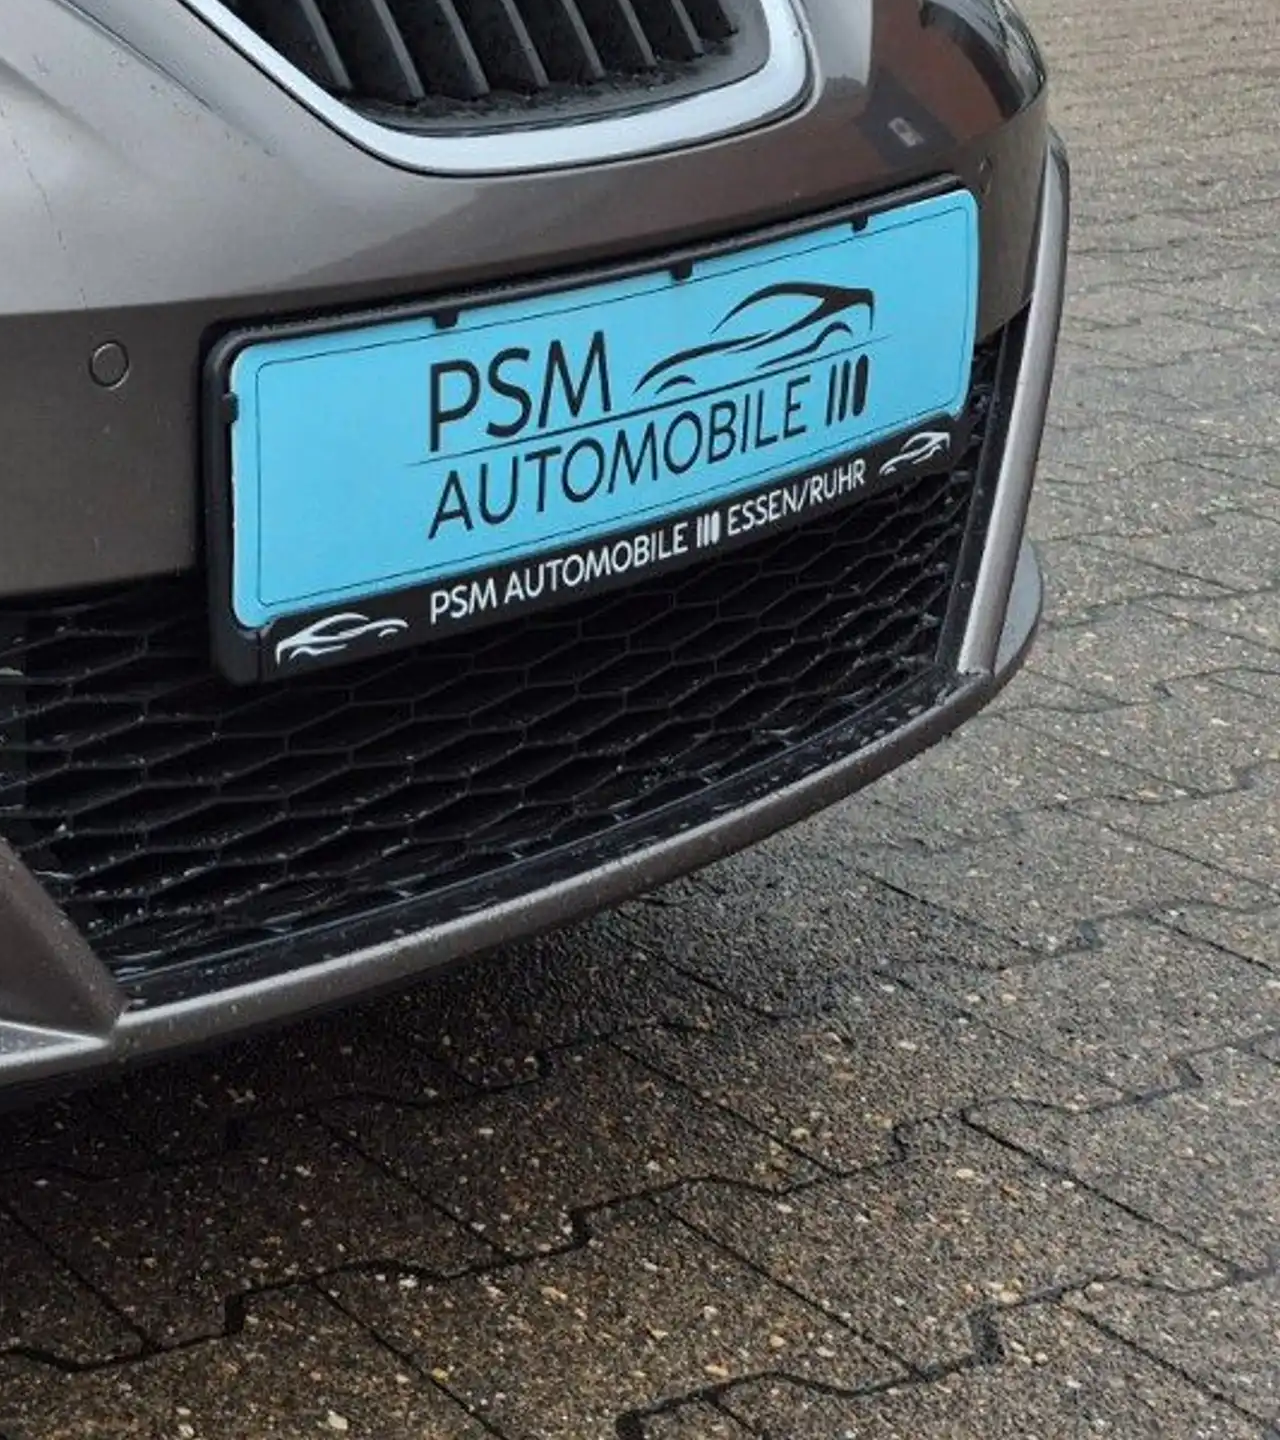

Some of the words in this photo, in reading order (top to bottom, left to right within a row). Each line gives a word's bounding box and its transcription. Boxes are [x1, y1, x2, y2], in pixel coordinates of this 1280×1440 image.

[428, 373, 811, 541] AUTOMOBILE
[429, 330, 612, 453] PSM
[430, 578, 497, 625] PSM
[503, 522, 689, 605] AUTOMOBILE
[727, 458, 867, 536] ESSEN/RUHR
